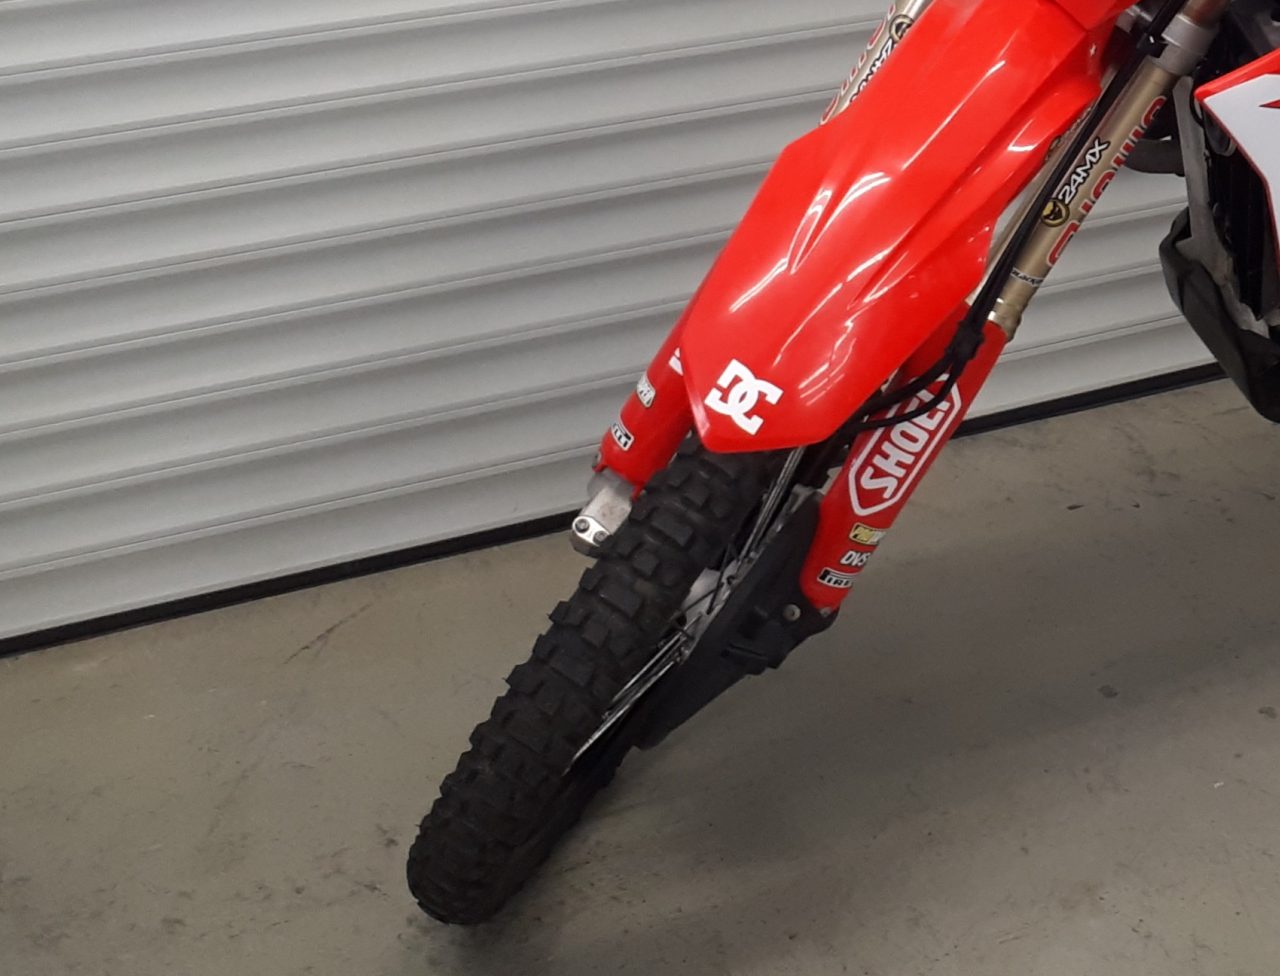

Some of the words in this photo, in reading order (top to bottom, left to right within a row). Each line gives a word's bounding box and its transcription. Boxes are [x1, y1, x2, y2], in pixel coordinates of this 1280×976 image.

[1058, 139, 1110, 205] 24MX
[704, 359, 784, 435] DC
[861, 387, 951, 499] SHOEI
